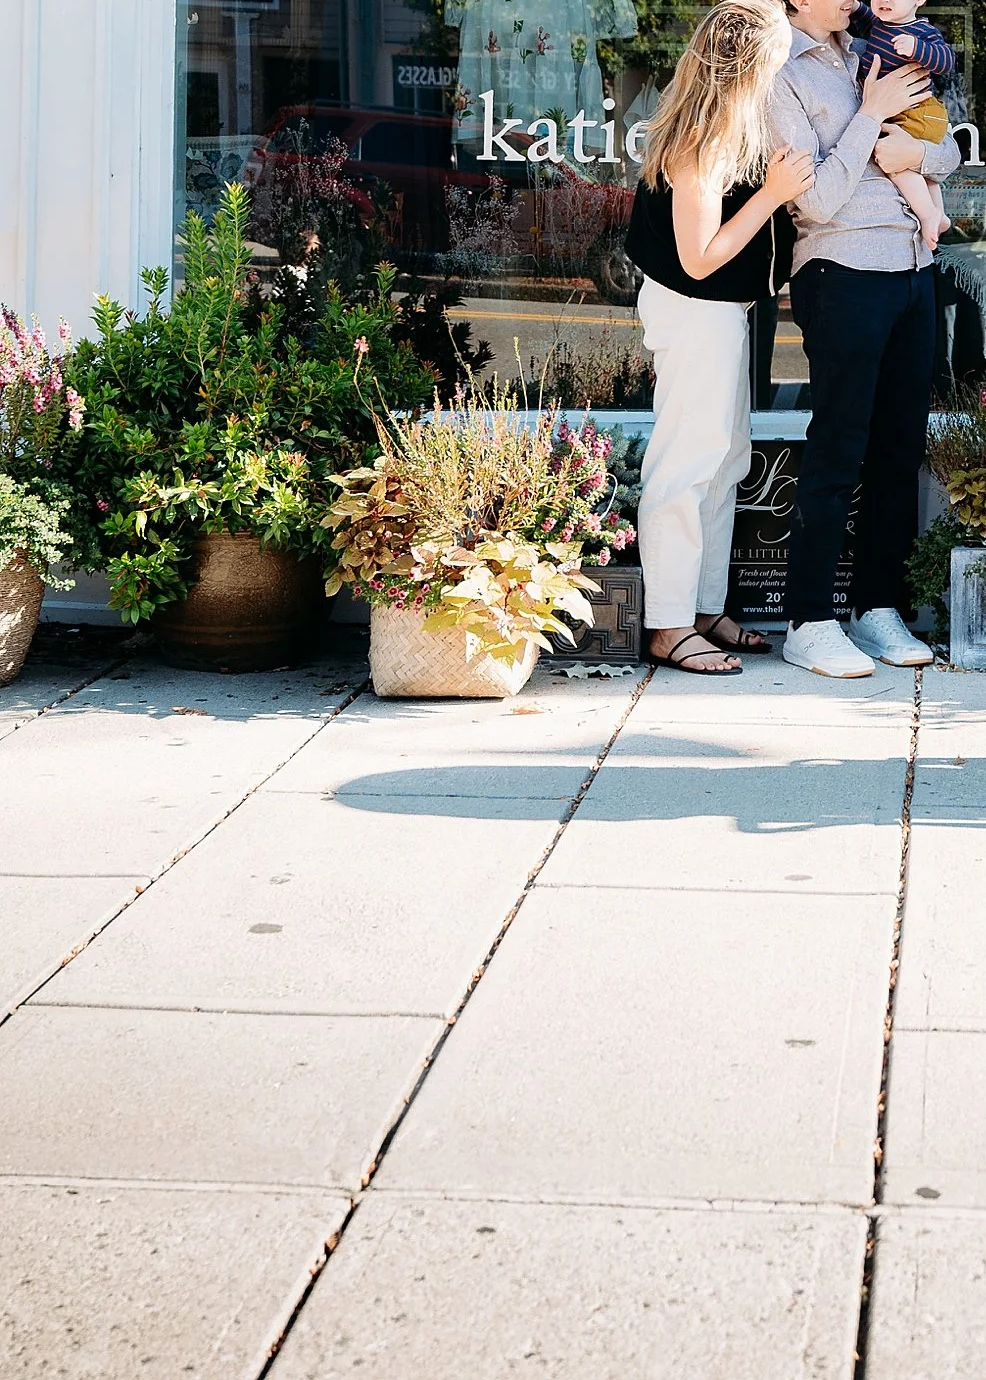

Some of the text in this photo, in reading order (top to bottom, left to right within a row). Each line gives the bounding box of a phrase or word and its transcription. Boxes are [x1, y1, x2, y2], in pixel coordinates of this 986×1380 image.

[475, 89, 650, 164] katie
[737, 568, 759, 579] Fresh
[768, 568, 788, 579] flowe
[738, 579, 760, 587] indoor
[759, 580, 780, 589] plants
